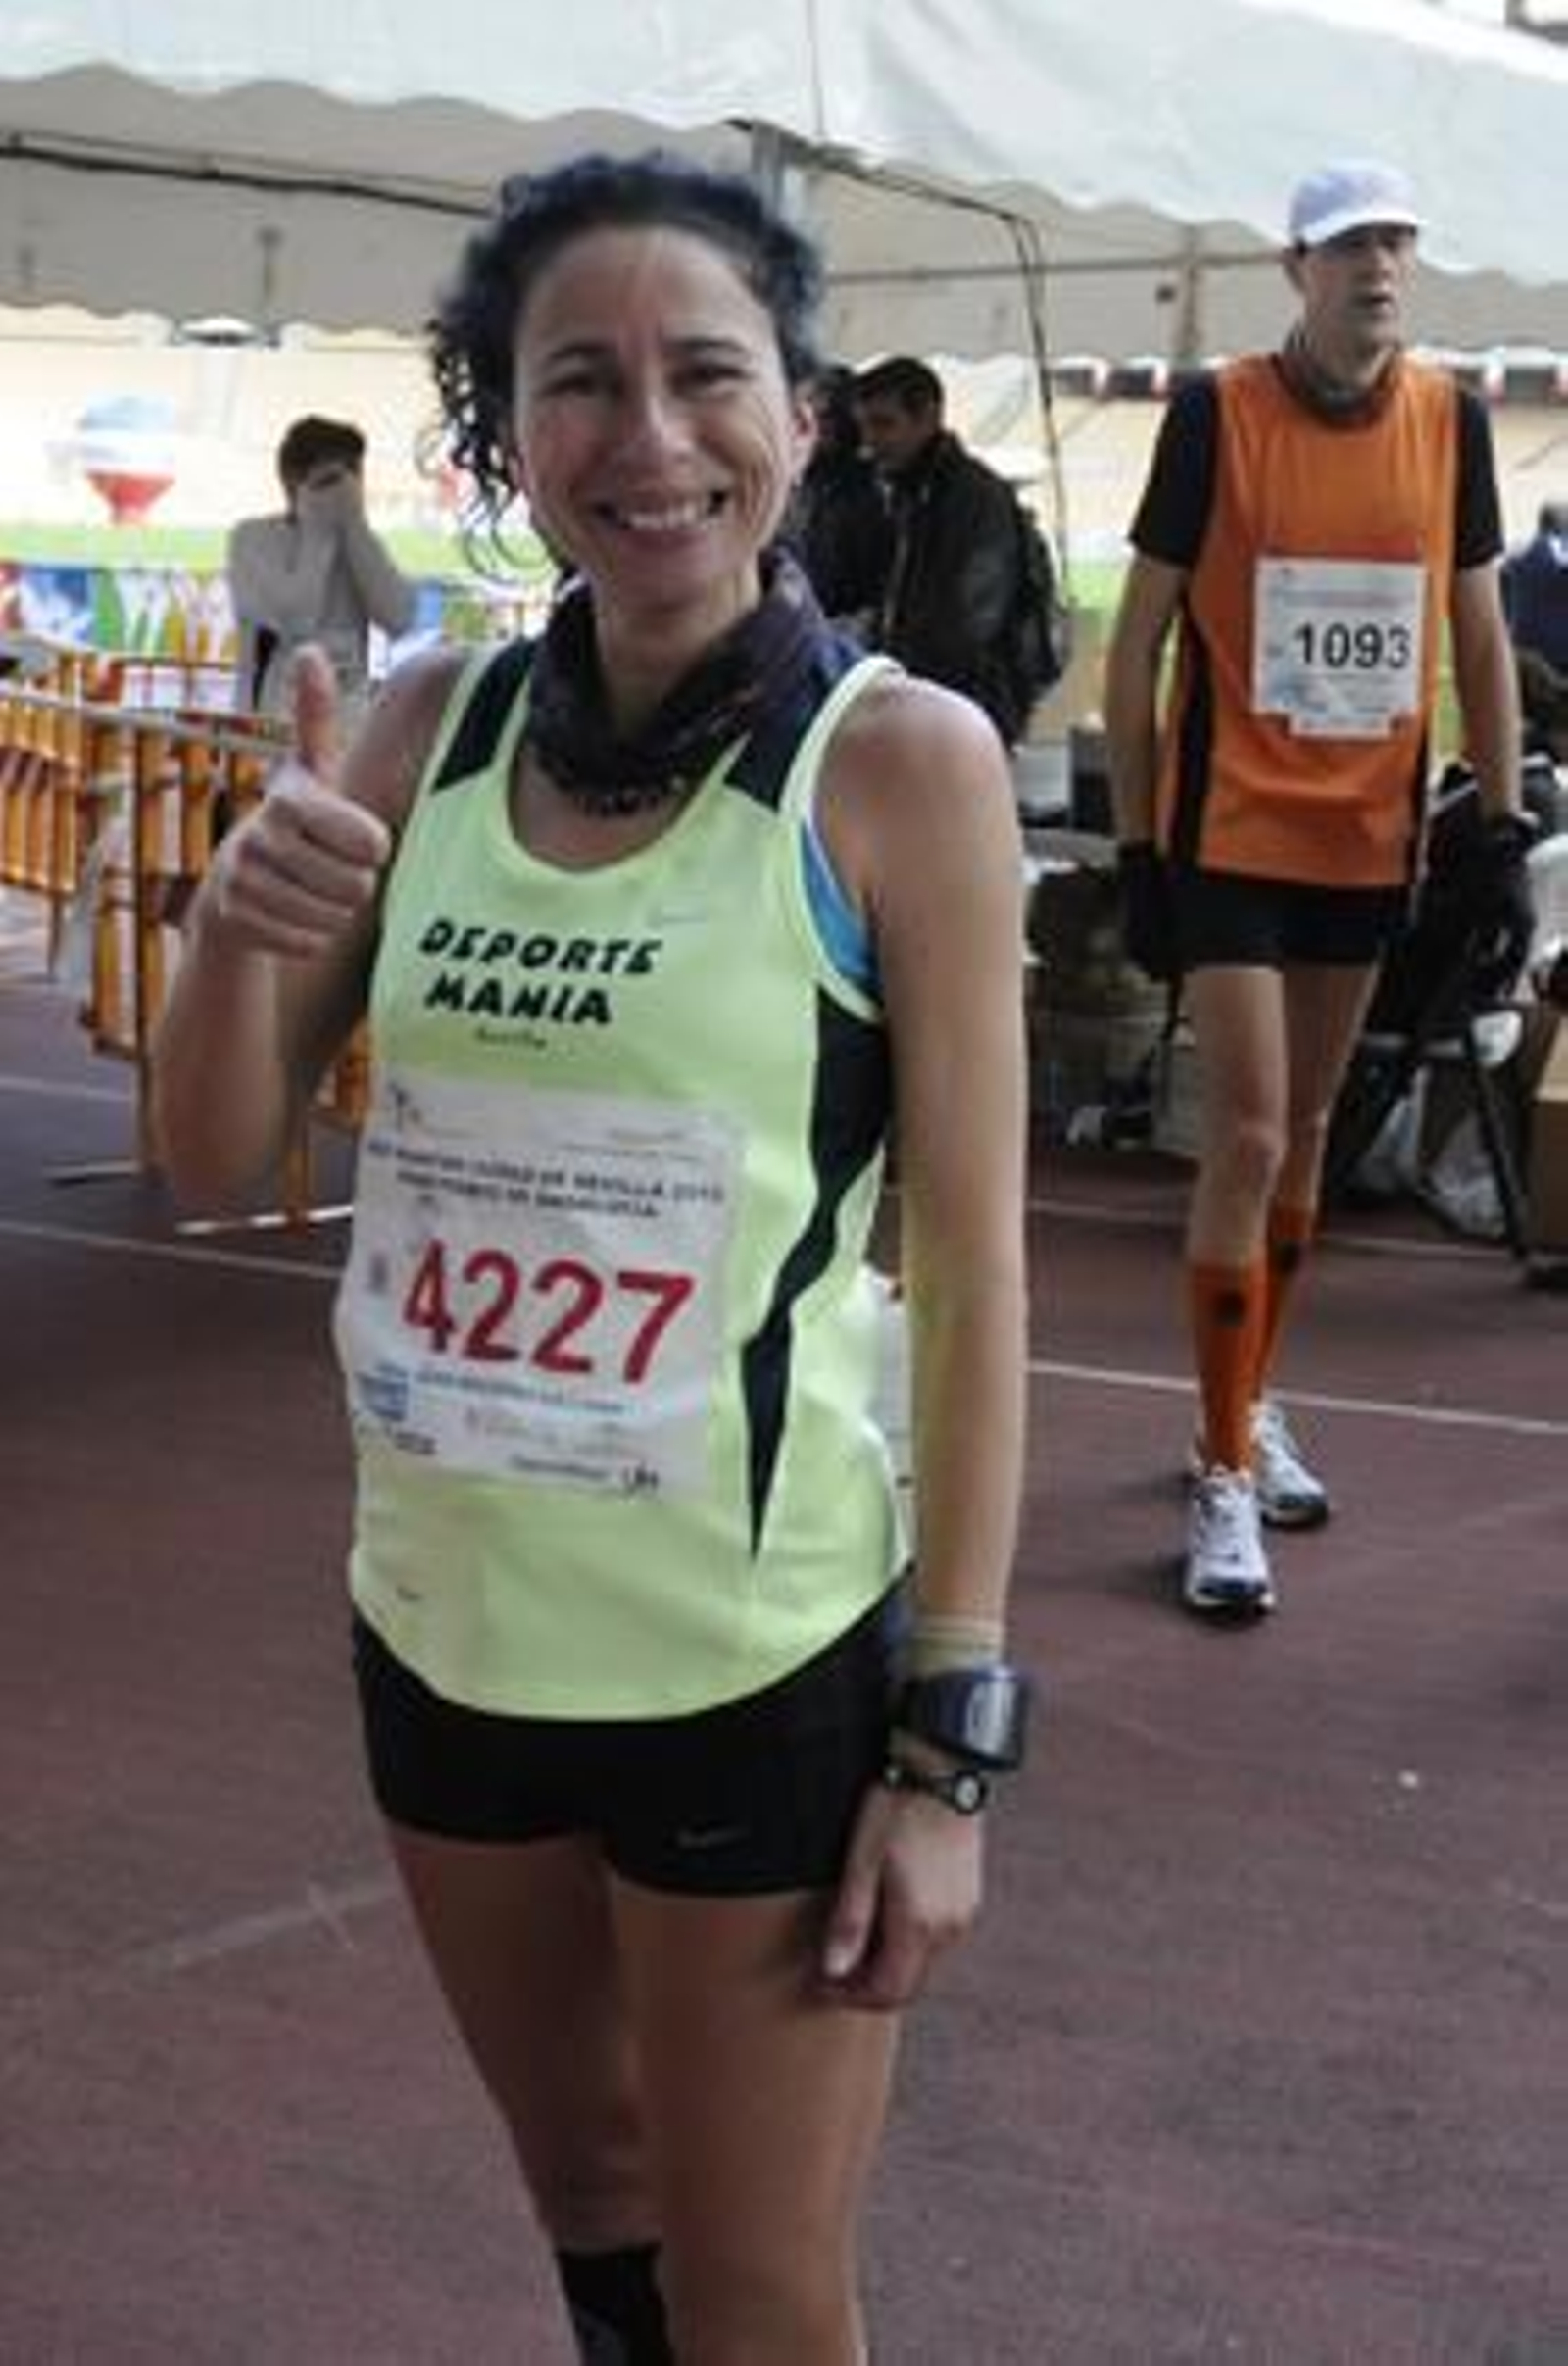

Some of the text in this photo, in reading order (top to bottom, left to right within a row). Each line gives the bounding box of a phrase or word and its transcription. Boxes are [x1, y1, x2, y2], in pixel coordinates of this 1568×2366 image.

[1293, 621, 1411, 670] 1093
[419, 919, 663, 975] DEPORTE
[423, 975, 612, 1024] MANIA
[403, 1239, 697, 1384] 4227
